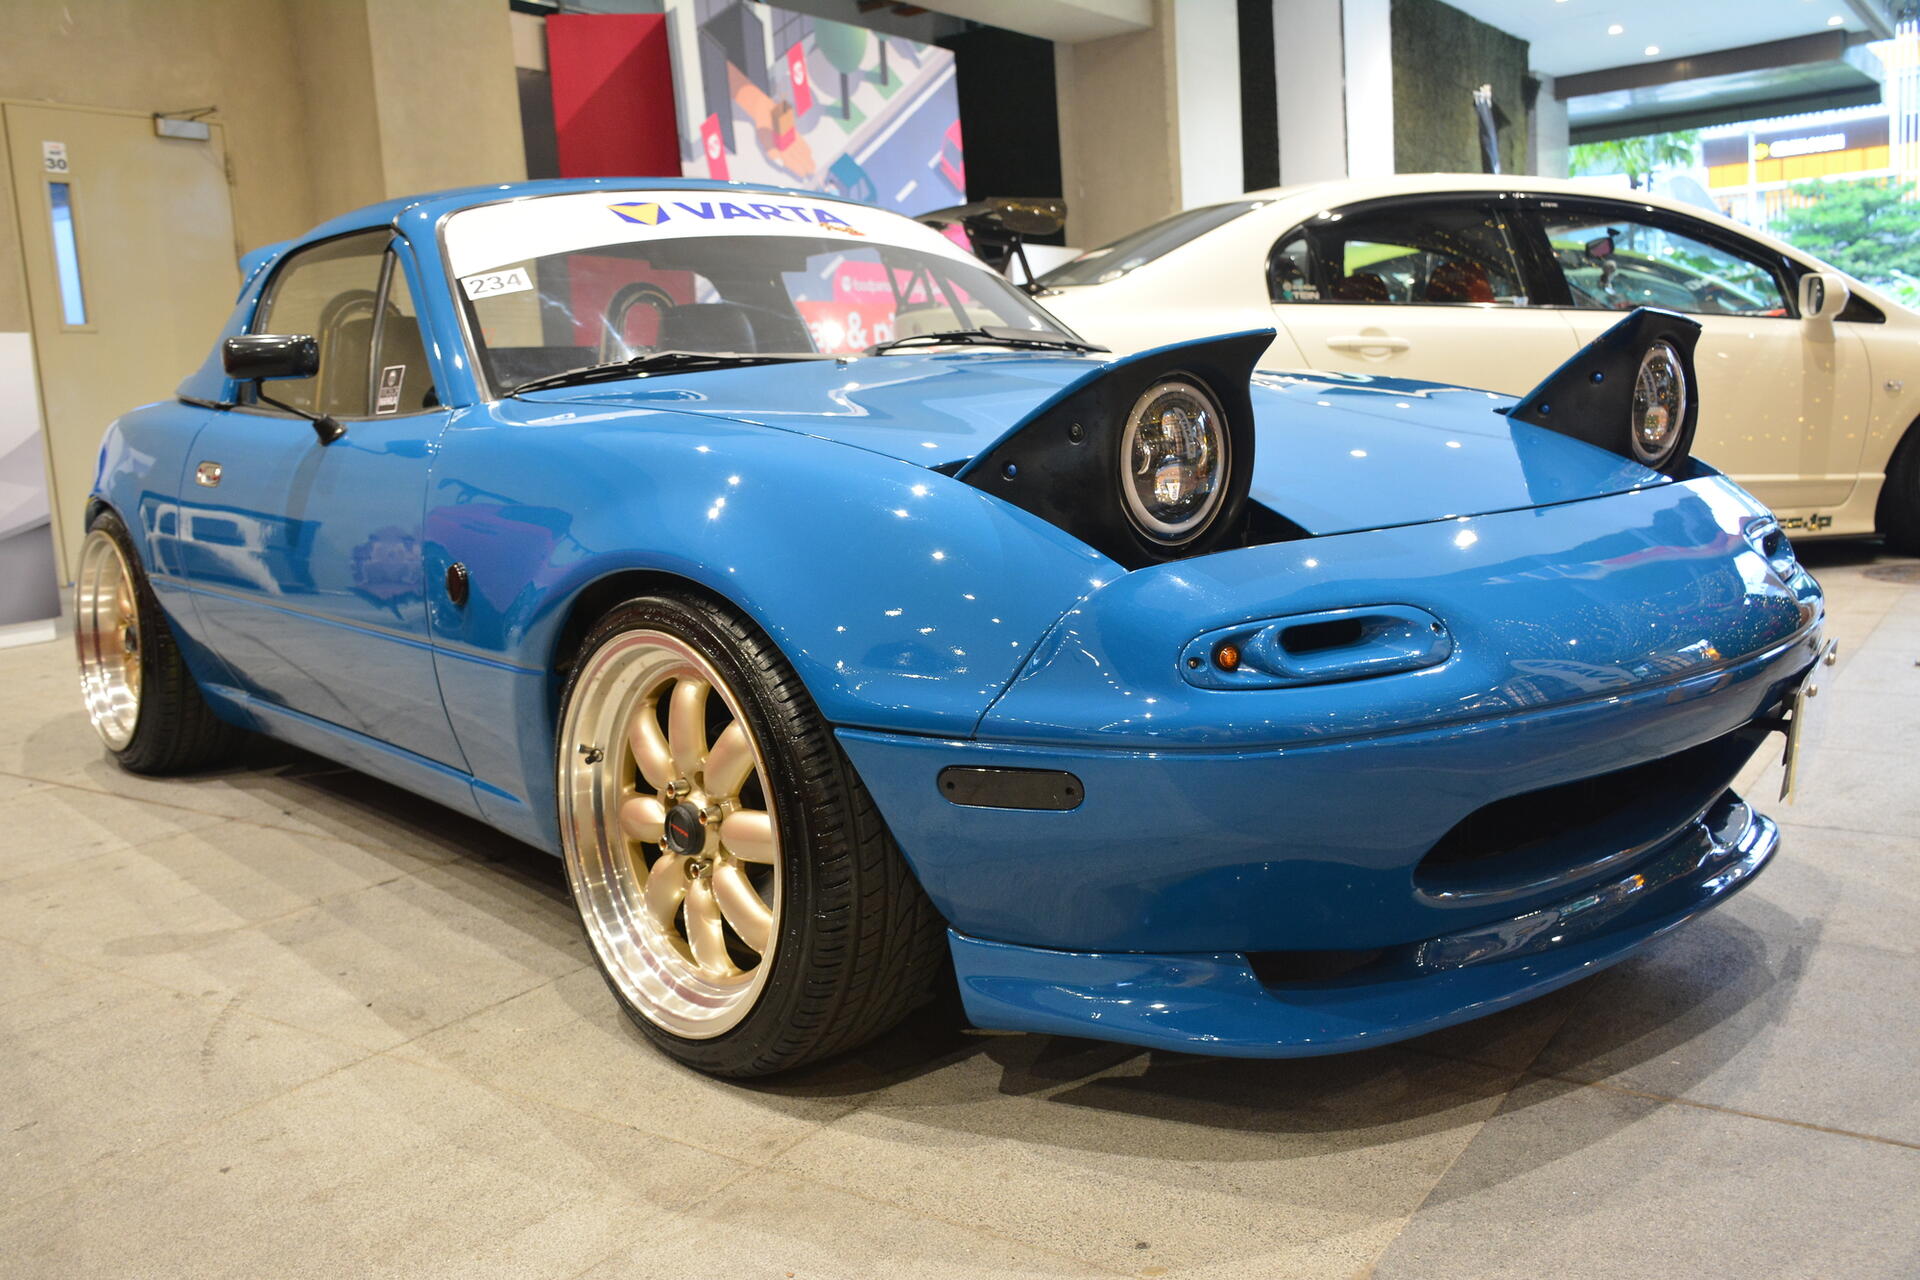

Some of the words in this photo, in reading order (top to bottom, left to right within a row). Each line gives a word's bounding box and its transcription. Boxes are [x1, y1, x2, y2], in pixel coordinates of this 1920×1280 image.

[46, 158, 68, 170] 30
[672, 202, 851, 227] VARTA
[469, 273, 523, 294] 234
